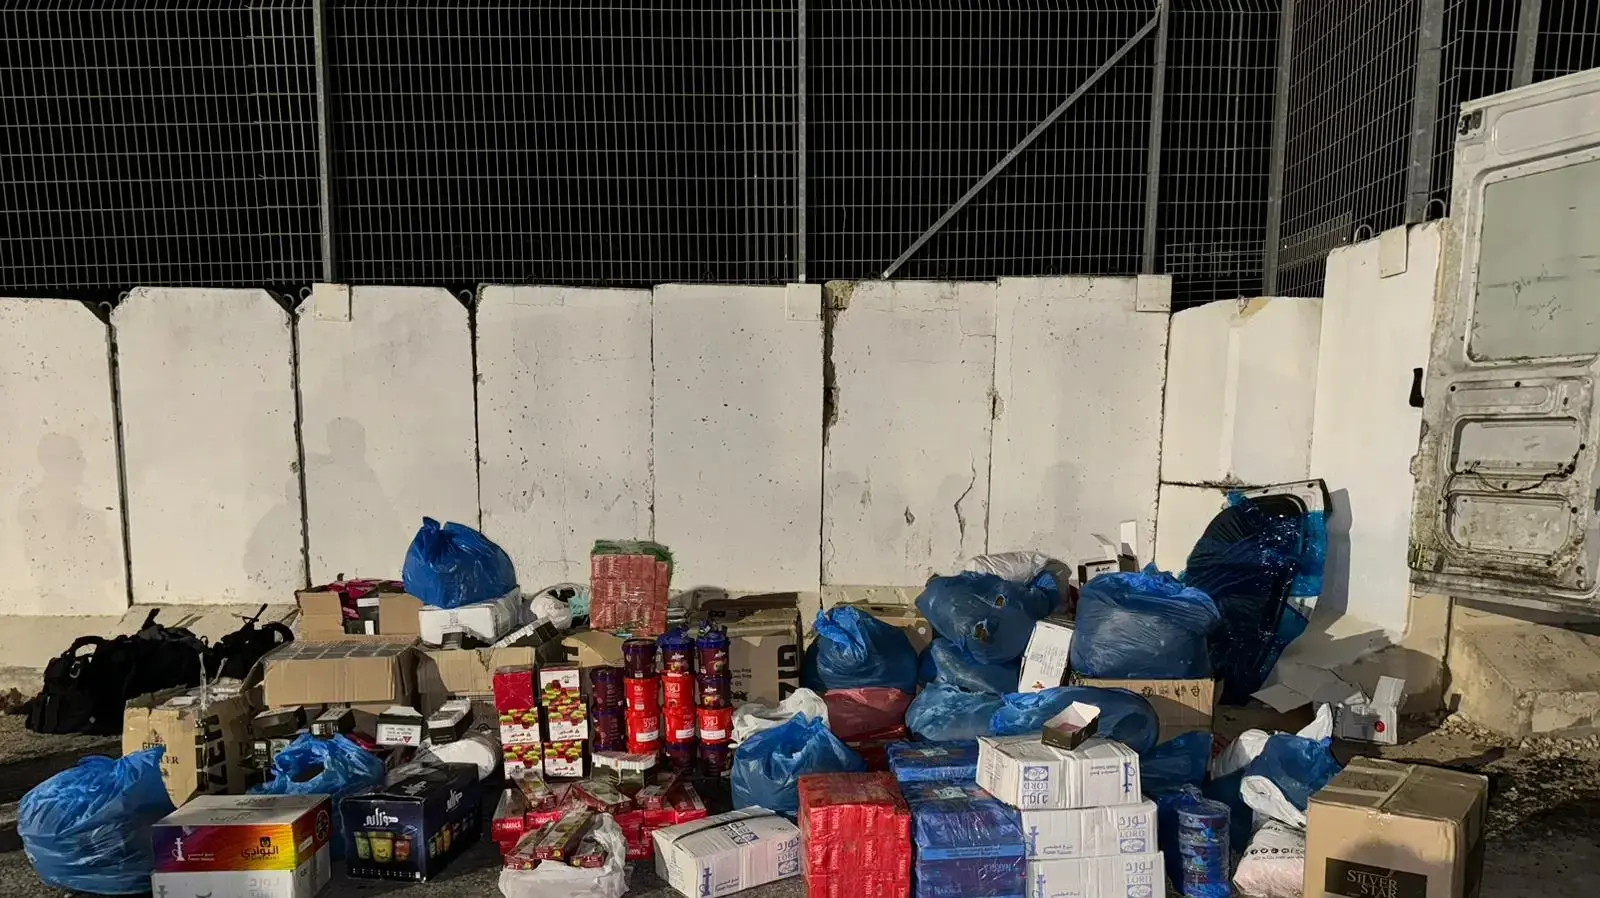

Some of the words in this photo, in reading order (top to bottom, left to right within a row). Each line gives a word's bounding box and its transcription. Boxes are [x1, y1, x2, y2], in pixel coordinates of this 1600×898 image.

[1023, 781, 1049, 790] LORD
[1119, 814, 1147, 828] لورد
[1120, 829, 1146, 838] LORD
[1125, 860, 1153, 873] لورد
[1127, 875, 1152, 883] LORD
[1347, 869, 1399, 891] SILVER
[1360, 885, 1397, 898] STAR
